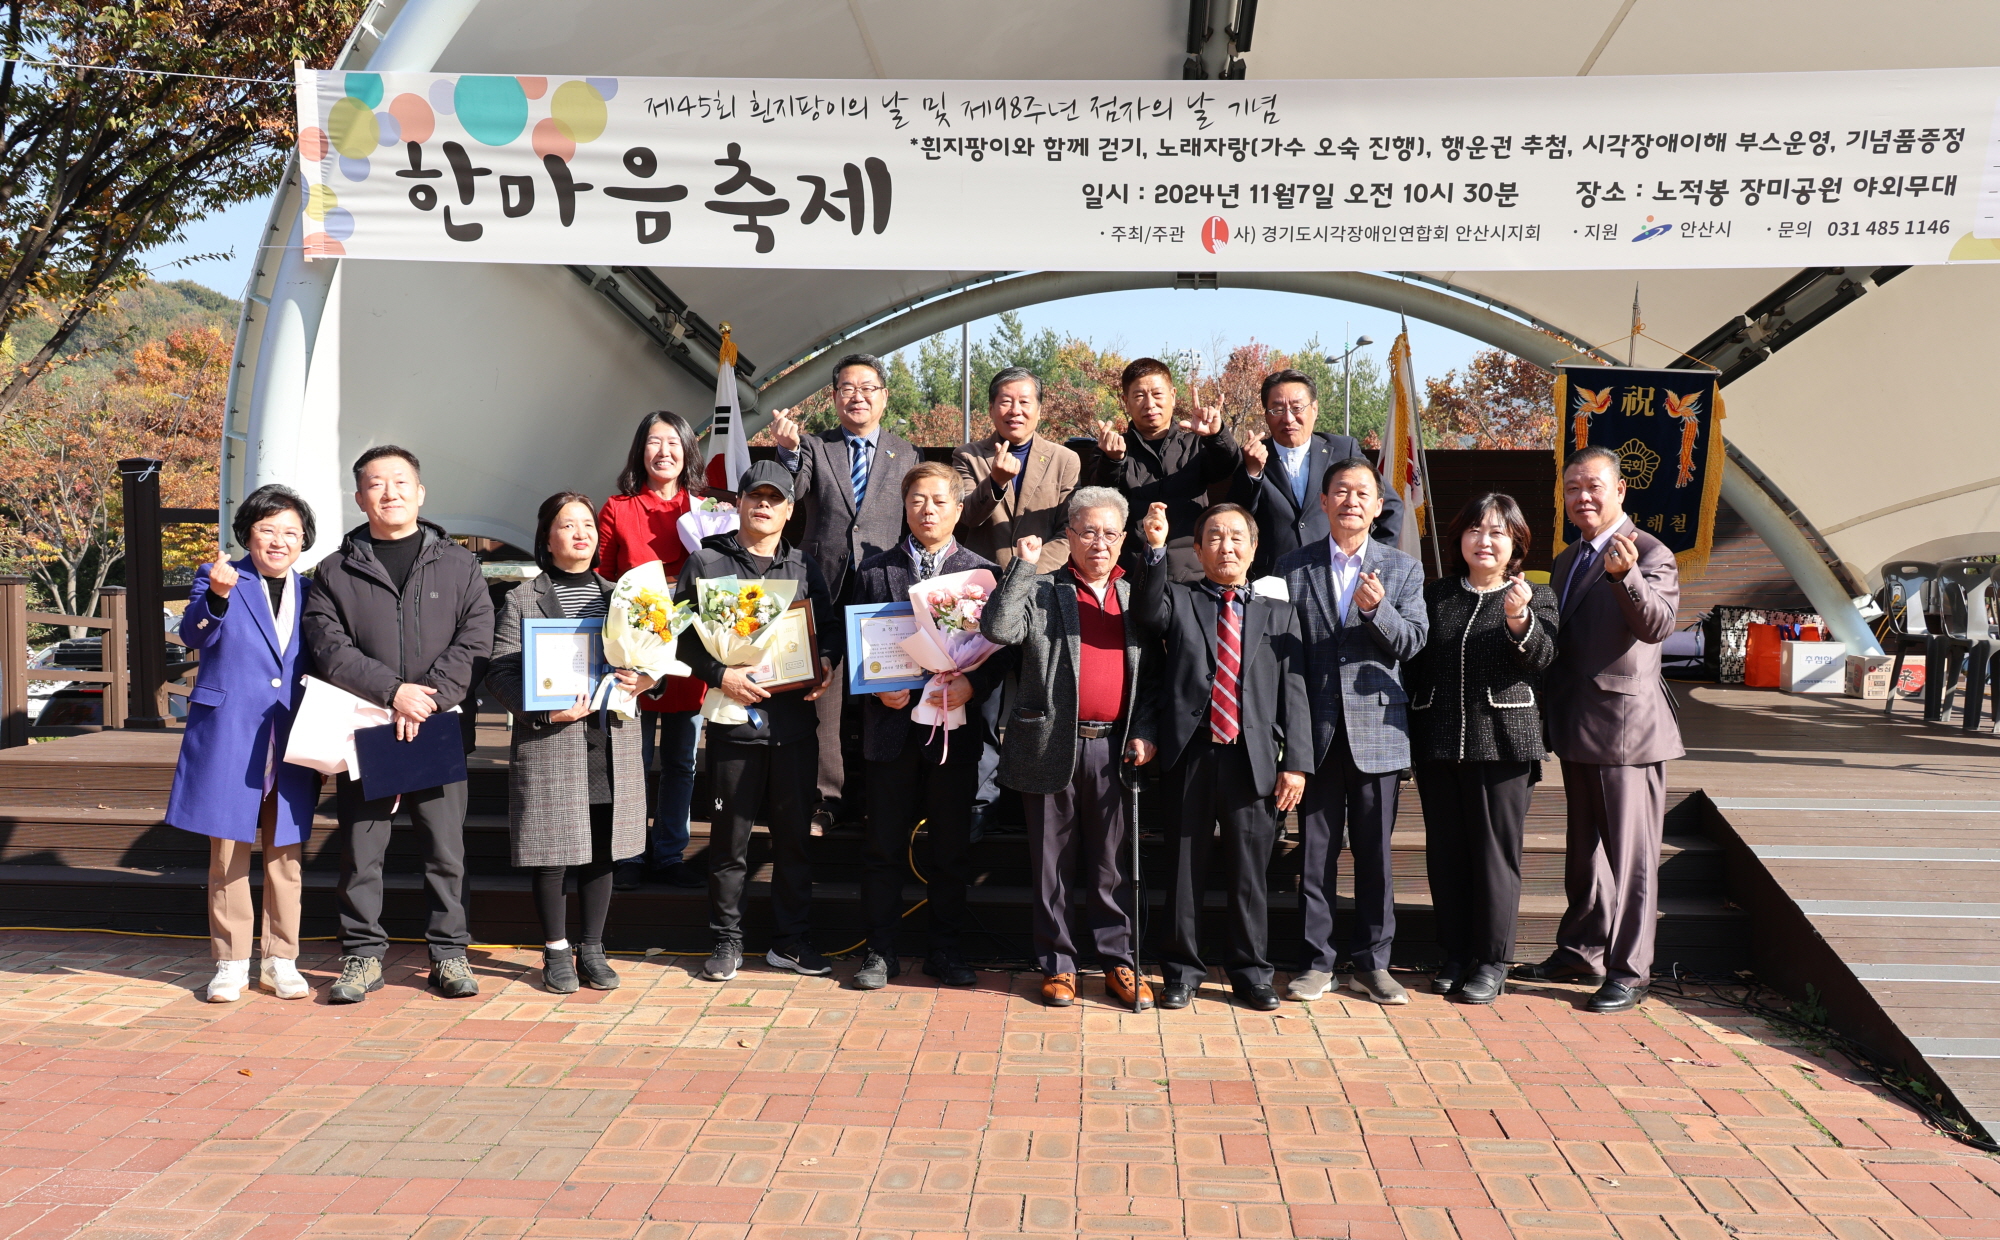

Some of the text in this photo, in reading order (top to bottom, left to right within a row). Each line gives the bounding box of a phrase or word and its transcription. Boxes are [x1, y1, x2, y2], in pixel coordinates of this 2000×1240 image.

[644, 90, 1281, 130] 제45회 흰지팡이의 날 및 제98주년 점자의 날 기념
[1043, 137, 1089, 162] 함께
[1098, 138, 1148, 162] 걷기,
[1156, 138, 1306, 162] 노래자랑(가수
[1314, 137, 1360, 161] 오숙
[1368, 136, 1432, 161] 진행),
[1441, 136, 1512, 161] 행운권
[1521, 134, 1573, 160] 추첨,
[1582, 132, 1727, 159] 시각장애이해
[1735, 131, 1836, 156] 부스운영,
[1846, 128, 1965, 154] 기념품증정
[396, 139, 891, 254] 한마음축제
[1082, 183, 1129, 210] 일시
[1154, 184, 1240, 209] 2024년
[1249, 183, 1334, 210] 11월7일
[1344, 183, 1393, 208] 오전
[1403, 183, 1454, 204] 10시
[1463, 182, 1520, 207] 30분
[1575, 181, 1627, 209] 장소
[1652, 179, 1730, 208] 노적봉
[1739, 177, 1843, 206] 장미공원
[1853, 175, 1958, 199] 야외무대
[1233, 225, 1257, 245] 사)
[1261, 223, 1449, 244] 경기도시각장애인연합회
[1455, 223, 1541, 242] 안산시지회
[1680, 220, 1732, 239] 안산시
[1827, 221, 1860, 237] 031
[1865, 220, 1900, 236] 485
[1904, 219, 1951, 235] 1146
[1620, 385, 1656, 417] 祝
[1620, 459, 1644, 473] 국회
